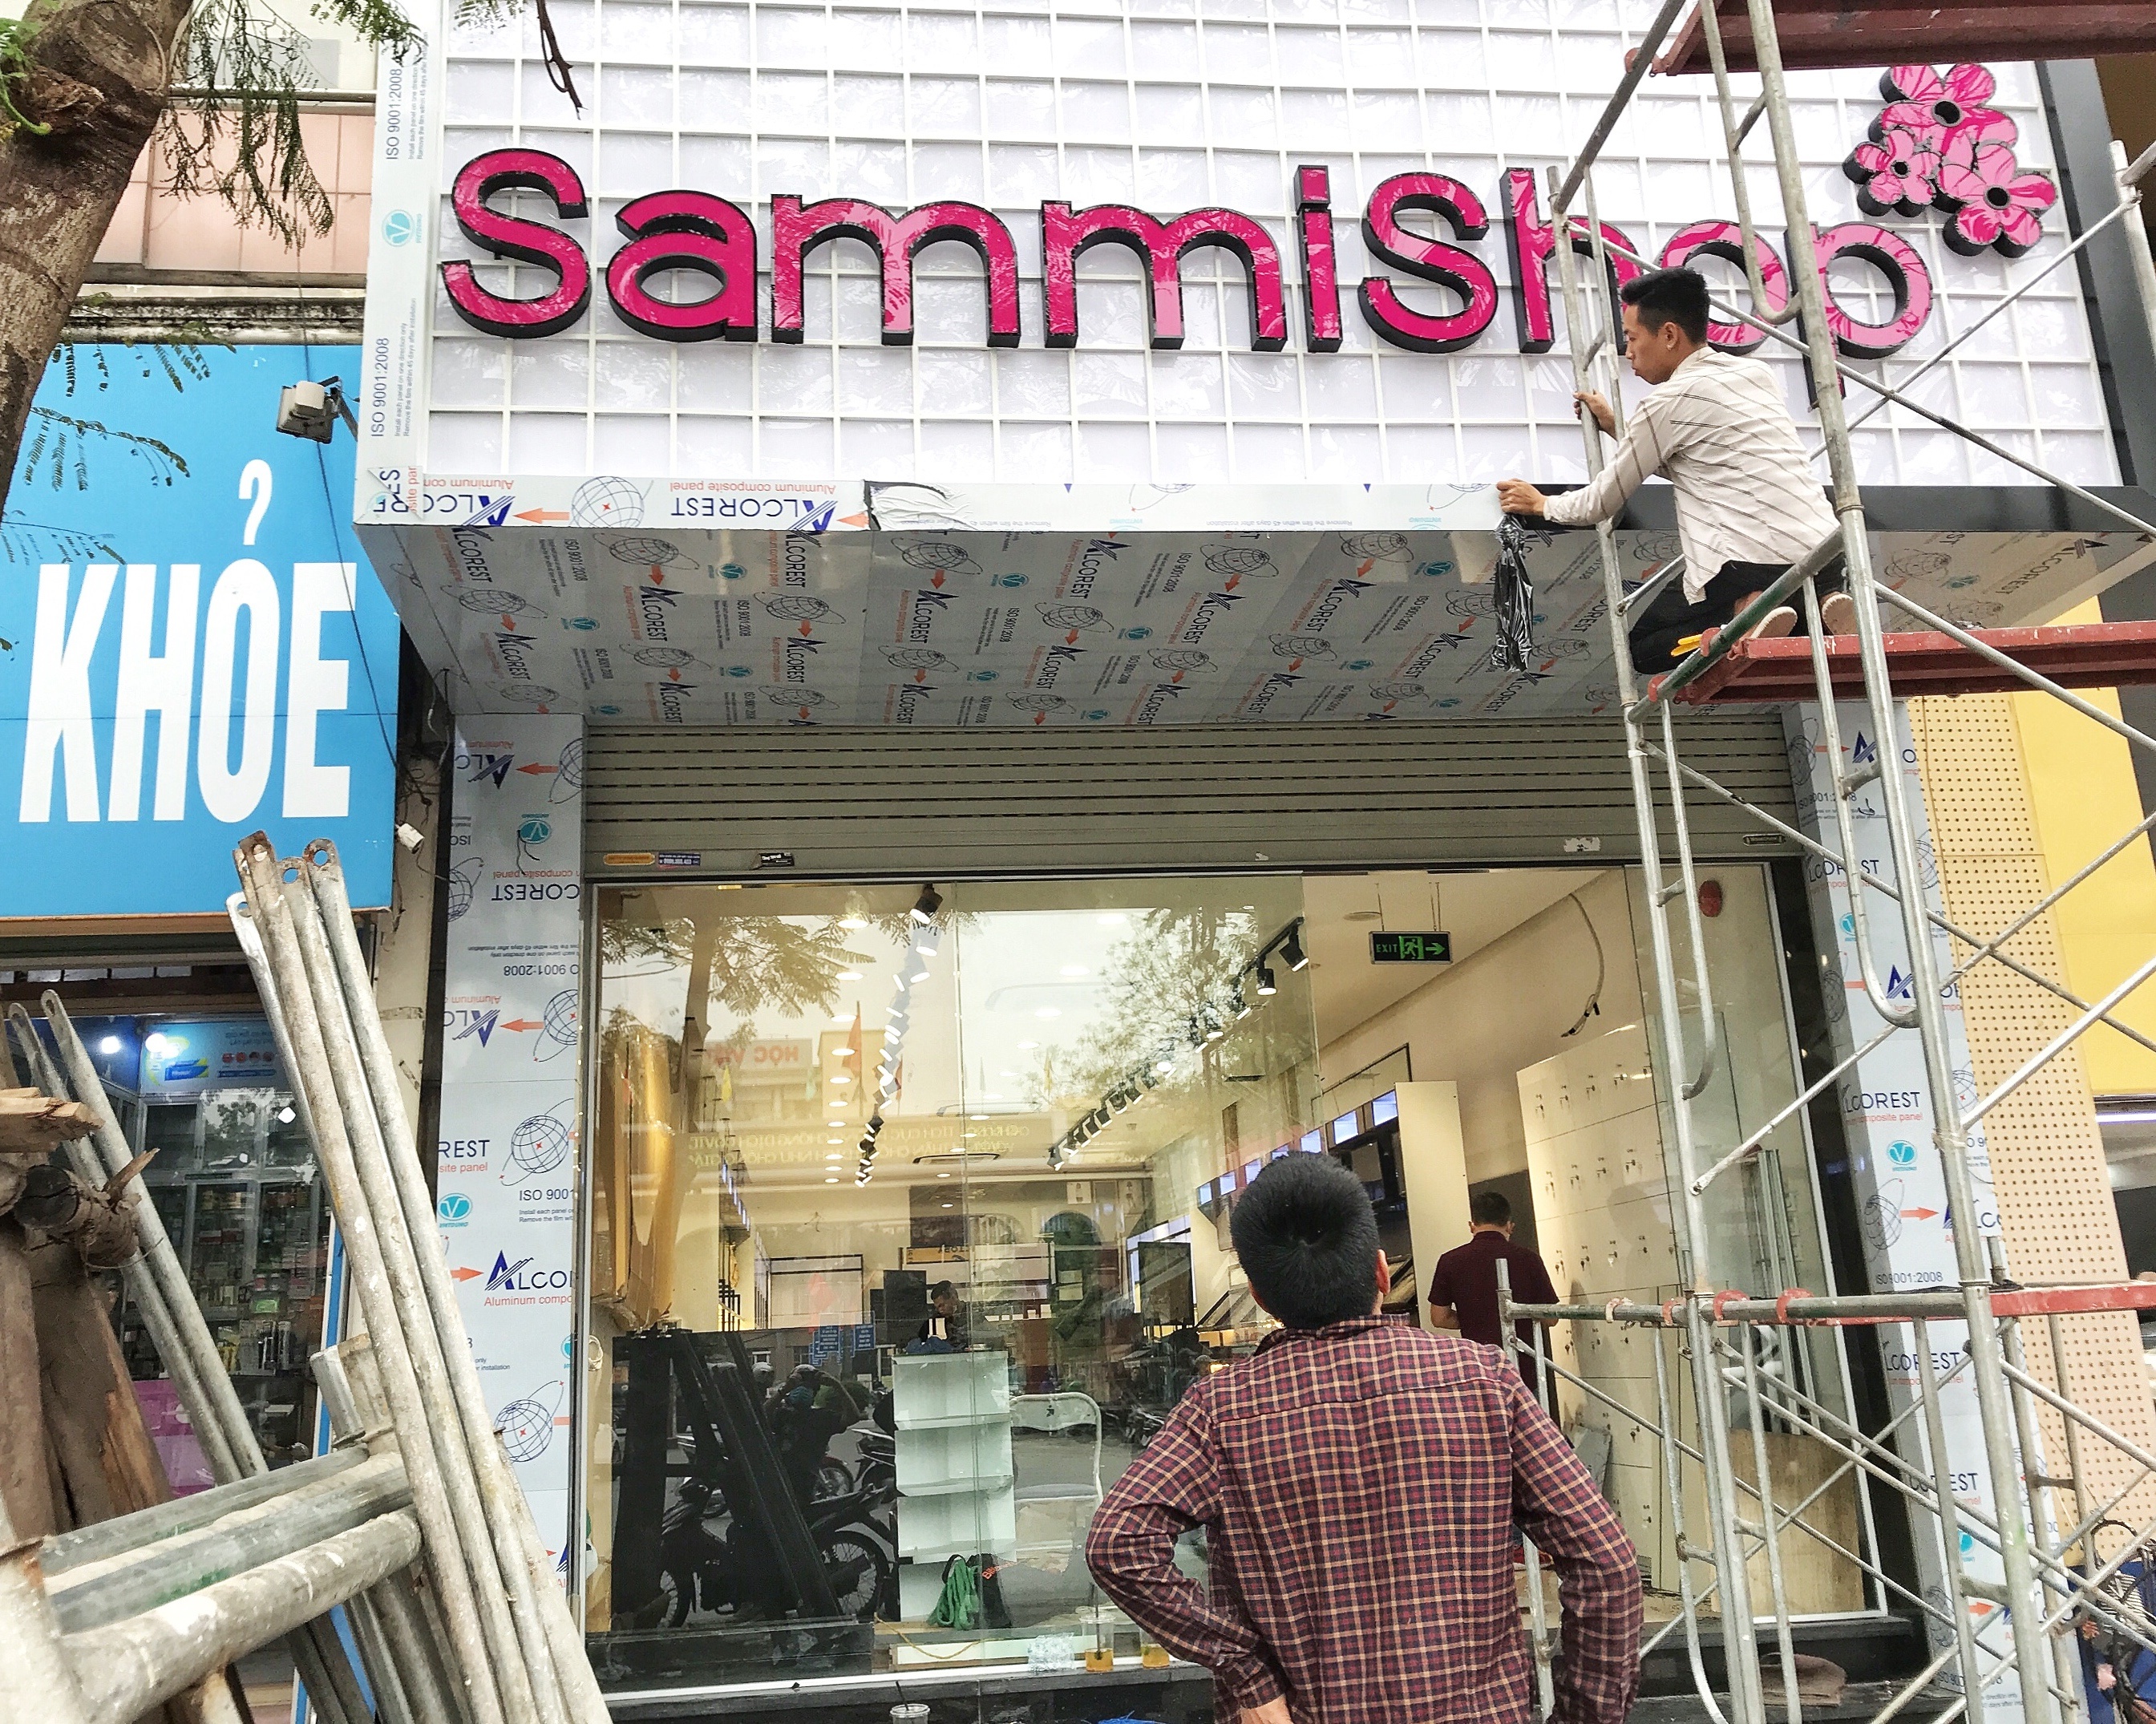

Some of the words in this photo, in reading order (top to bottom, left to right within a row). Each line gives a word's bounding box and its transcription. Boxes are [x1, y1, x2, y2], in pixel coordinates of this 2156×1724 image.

[387, 69, 402, 132] 9001:2008
[386, 136, 399, 160] ISO
[372, 338, 389, 407] 9001:2008
[371, 412, 385, 437] ISO
[669, 482, 704, 494] panel
[708, 483, 766, 494] composite
[770, 484, 837, 495] Aluminum
[671, 499, 838, 531] ALCOREST
[19, 459, 357, 824] KHỎE
[1375, 944, 1398, 954] EXIT
[504, 965, 566, 976] 9001:2008
[459, 1163, 488, 1174] panel
[520, 1190, 542, 1201] ISO
[484, 1297, 536, 1306] Aluminum
